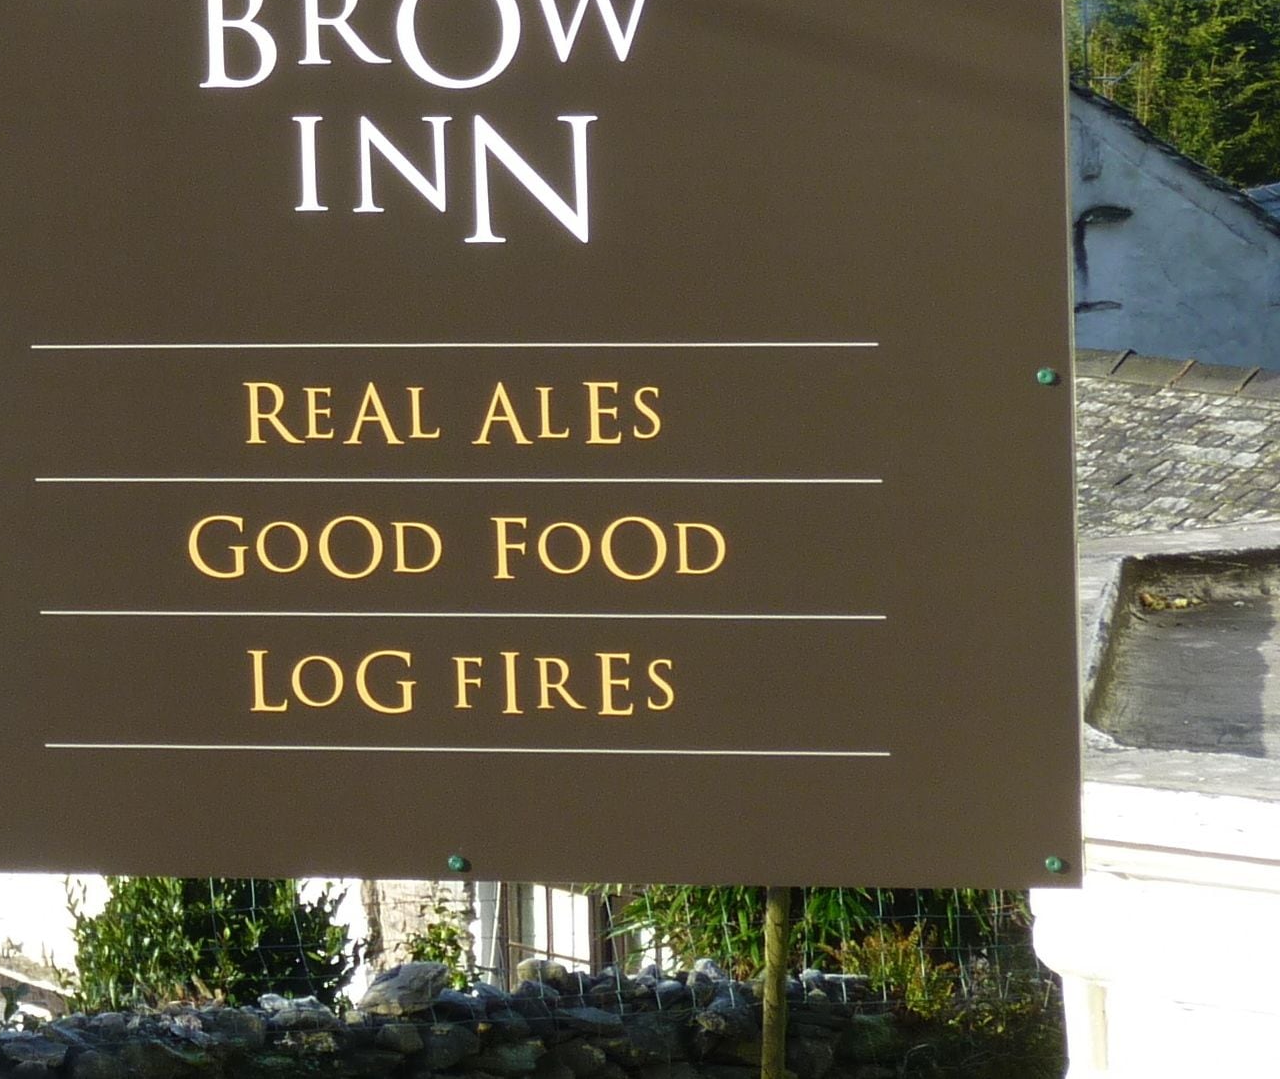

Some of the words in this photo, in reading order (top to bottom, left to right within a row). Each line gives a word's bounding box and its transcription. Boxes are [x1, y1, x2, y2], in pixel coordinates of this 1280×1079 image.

[292, 115, 598, 243] INN
[243, 382, 440, 444] REAL
[472, 382, 661, 444] ALES
[188, 515, 442, 579] GOOD
[491, 517, 726, 580] FOOD
[248, 650, 416, 713] LOG
[452, 652, 675, 715] FIRES
